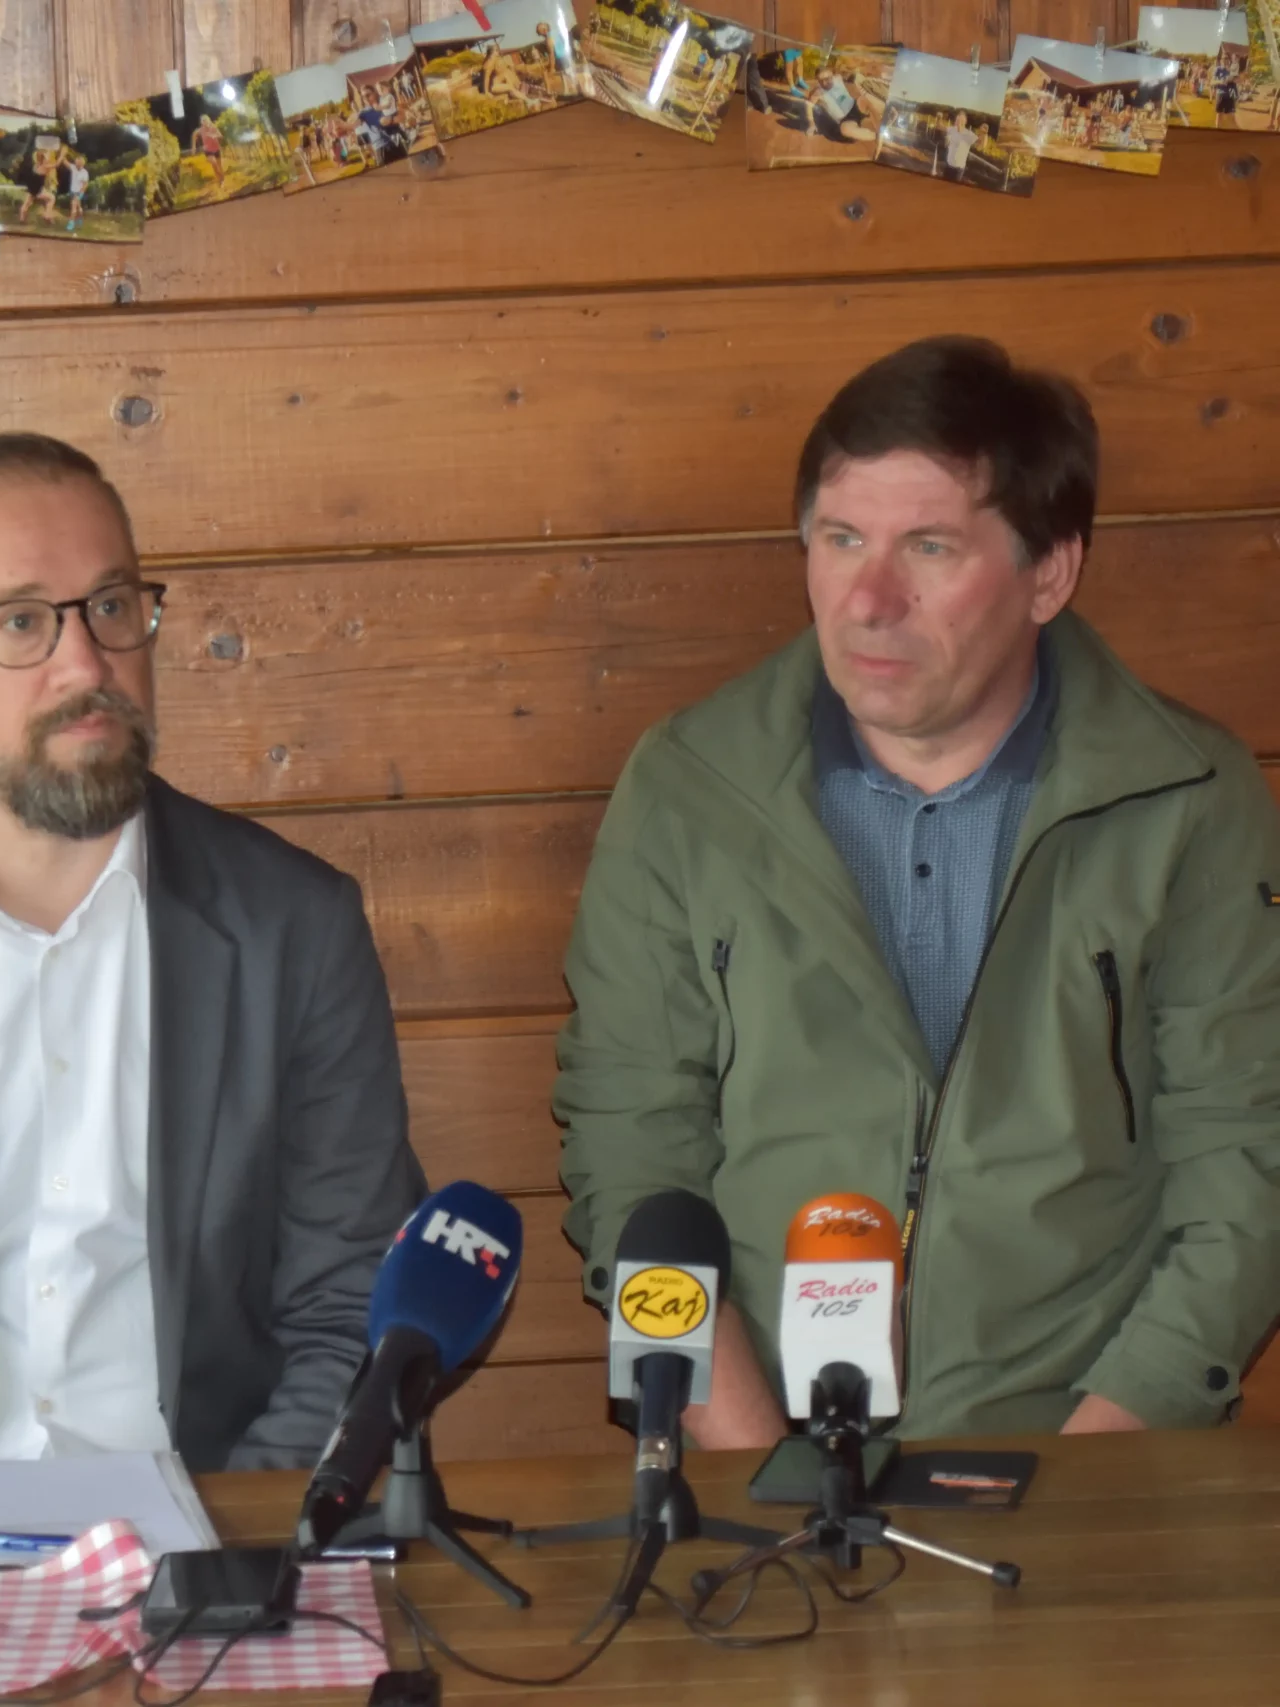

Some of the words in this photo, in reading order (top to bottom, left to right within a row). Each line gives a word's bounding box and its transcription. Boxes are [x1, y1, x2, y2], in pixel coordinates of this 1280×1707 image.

[422, 1209, 511, 1280] HRT
[796, 1277, 879, 1302] Radio
[624, 1289, 704, 1327] Kaj
[810, 1299, 863, 1319] 105
